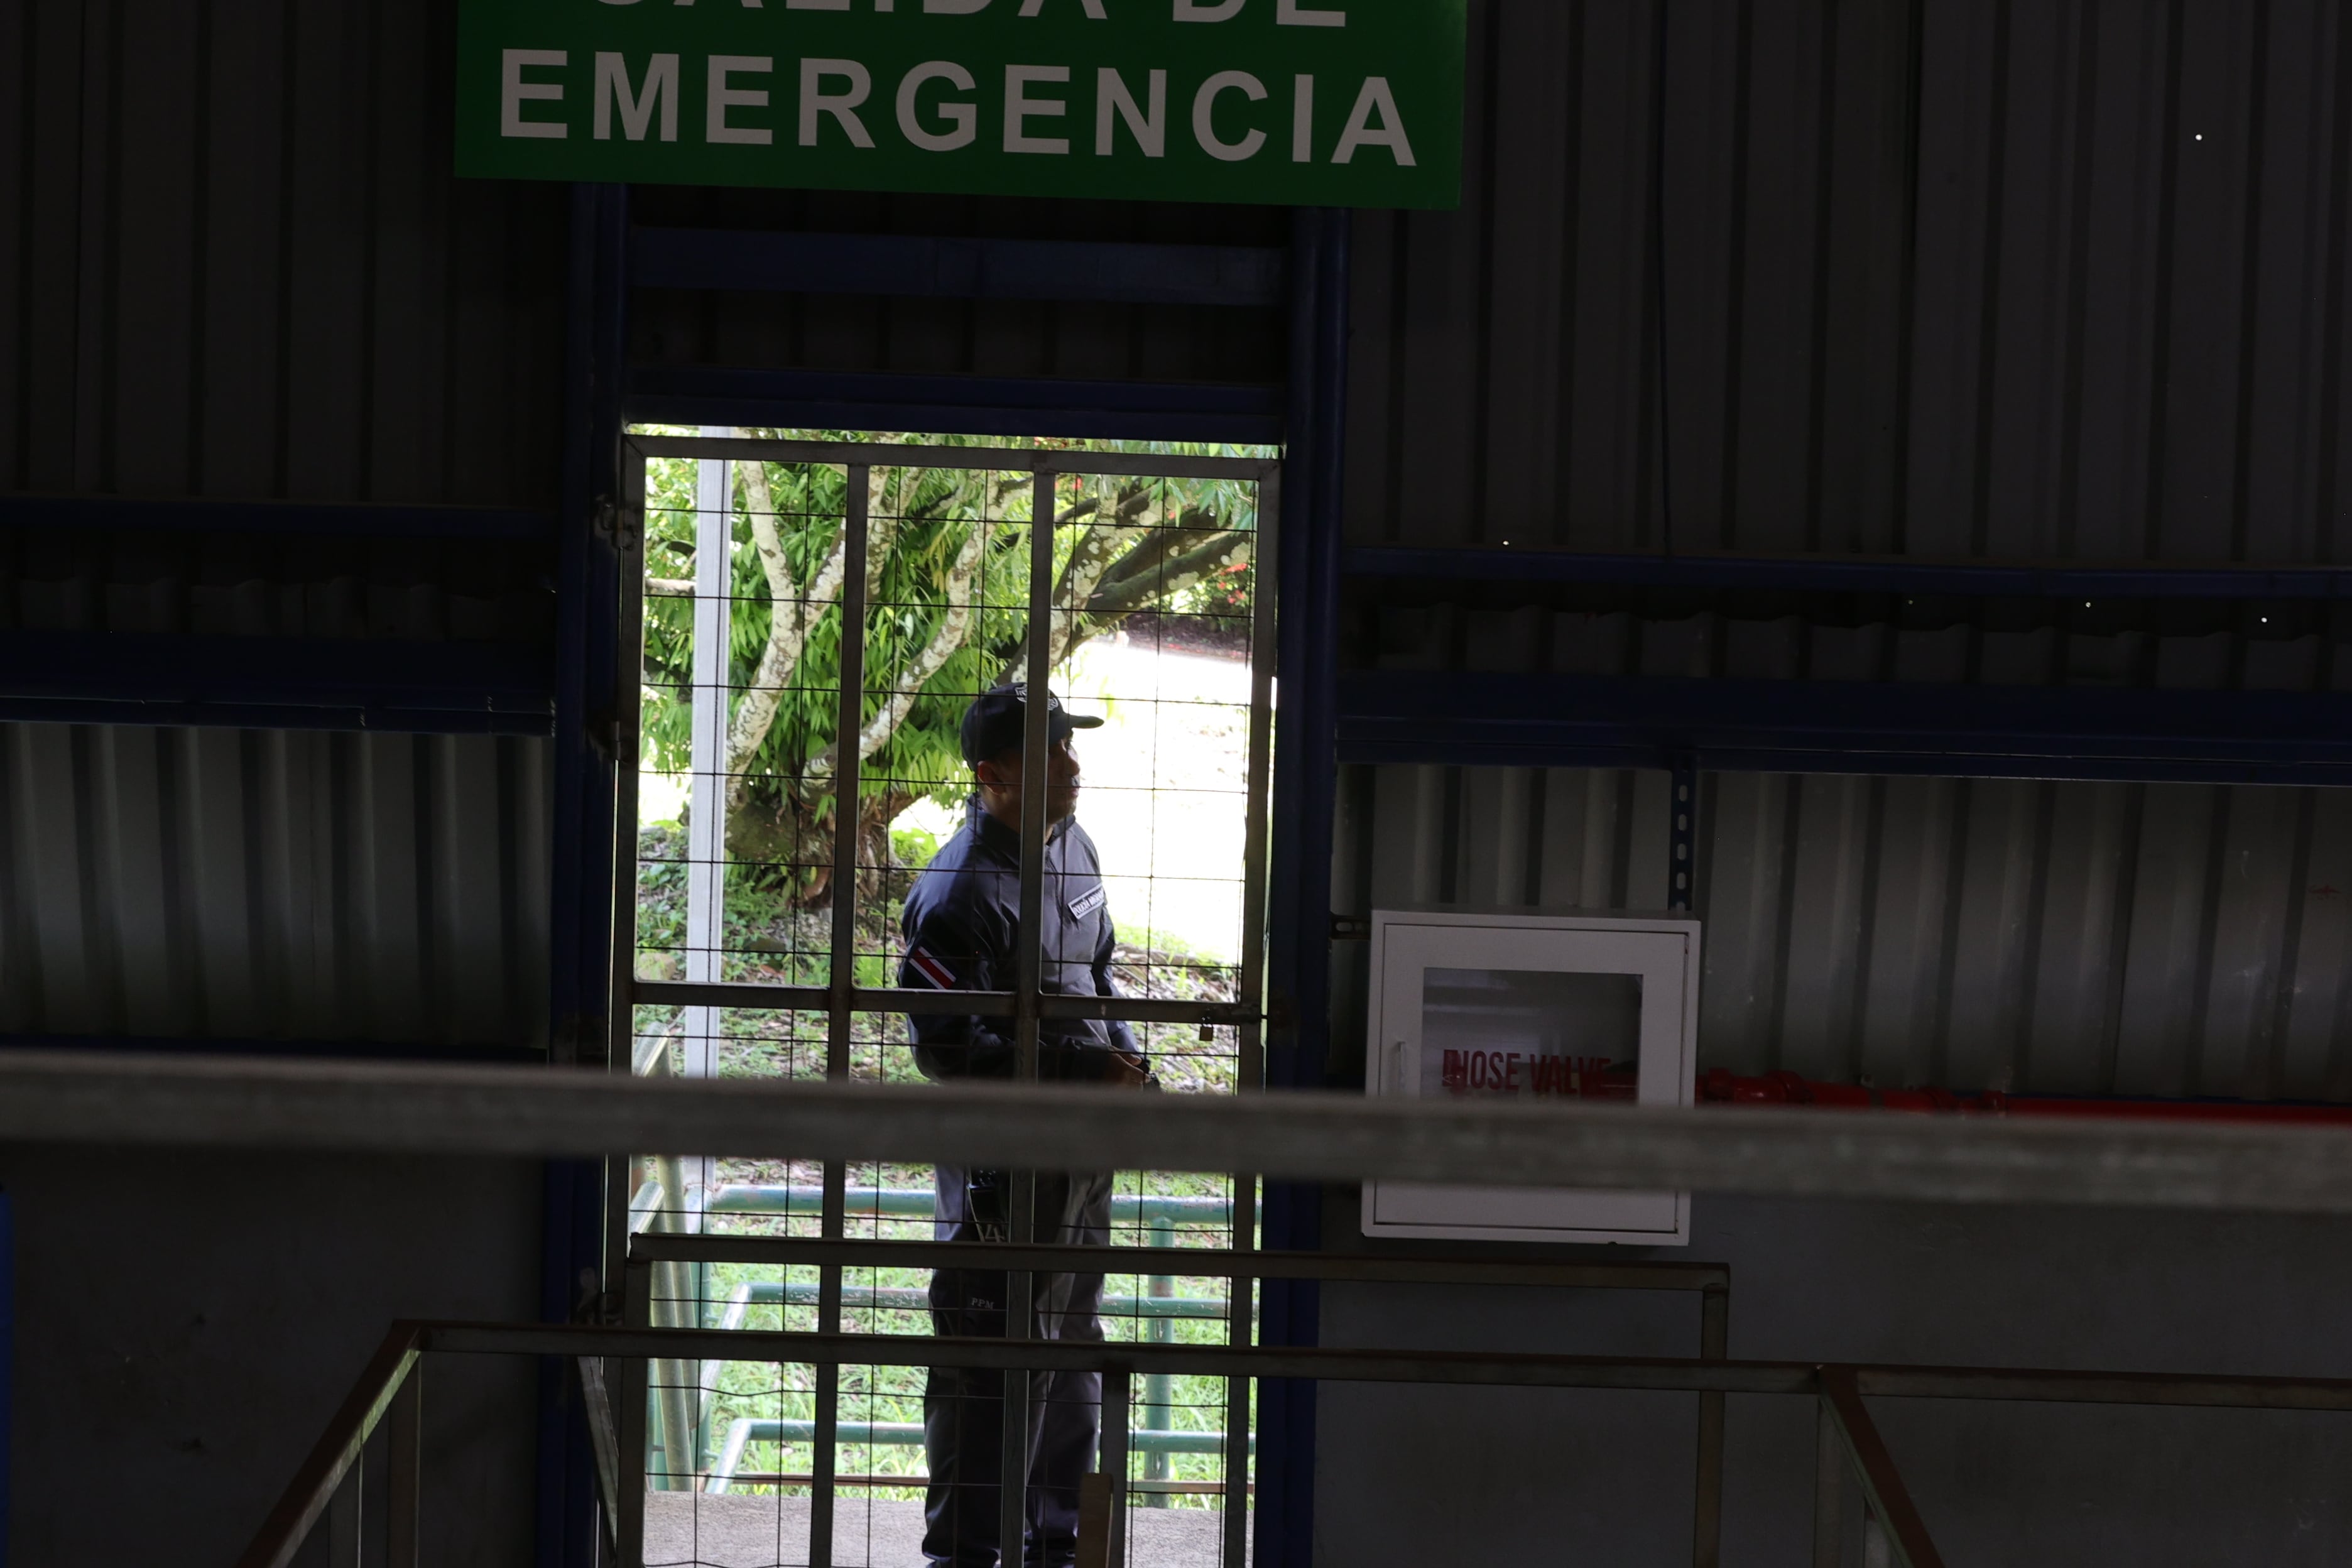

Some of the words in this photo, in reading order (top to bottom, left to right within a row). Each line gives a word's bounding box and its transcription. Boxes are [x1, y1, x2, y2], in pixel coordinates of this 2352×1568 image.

[501, 48, 1417, 166] EMERGENCIA
[1442, 1049, 1521, 1090] HOSE
[1530, 1054, 1611, 1096] VALVE
[971, 1297, 994, 1310] PPM
